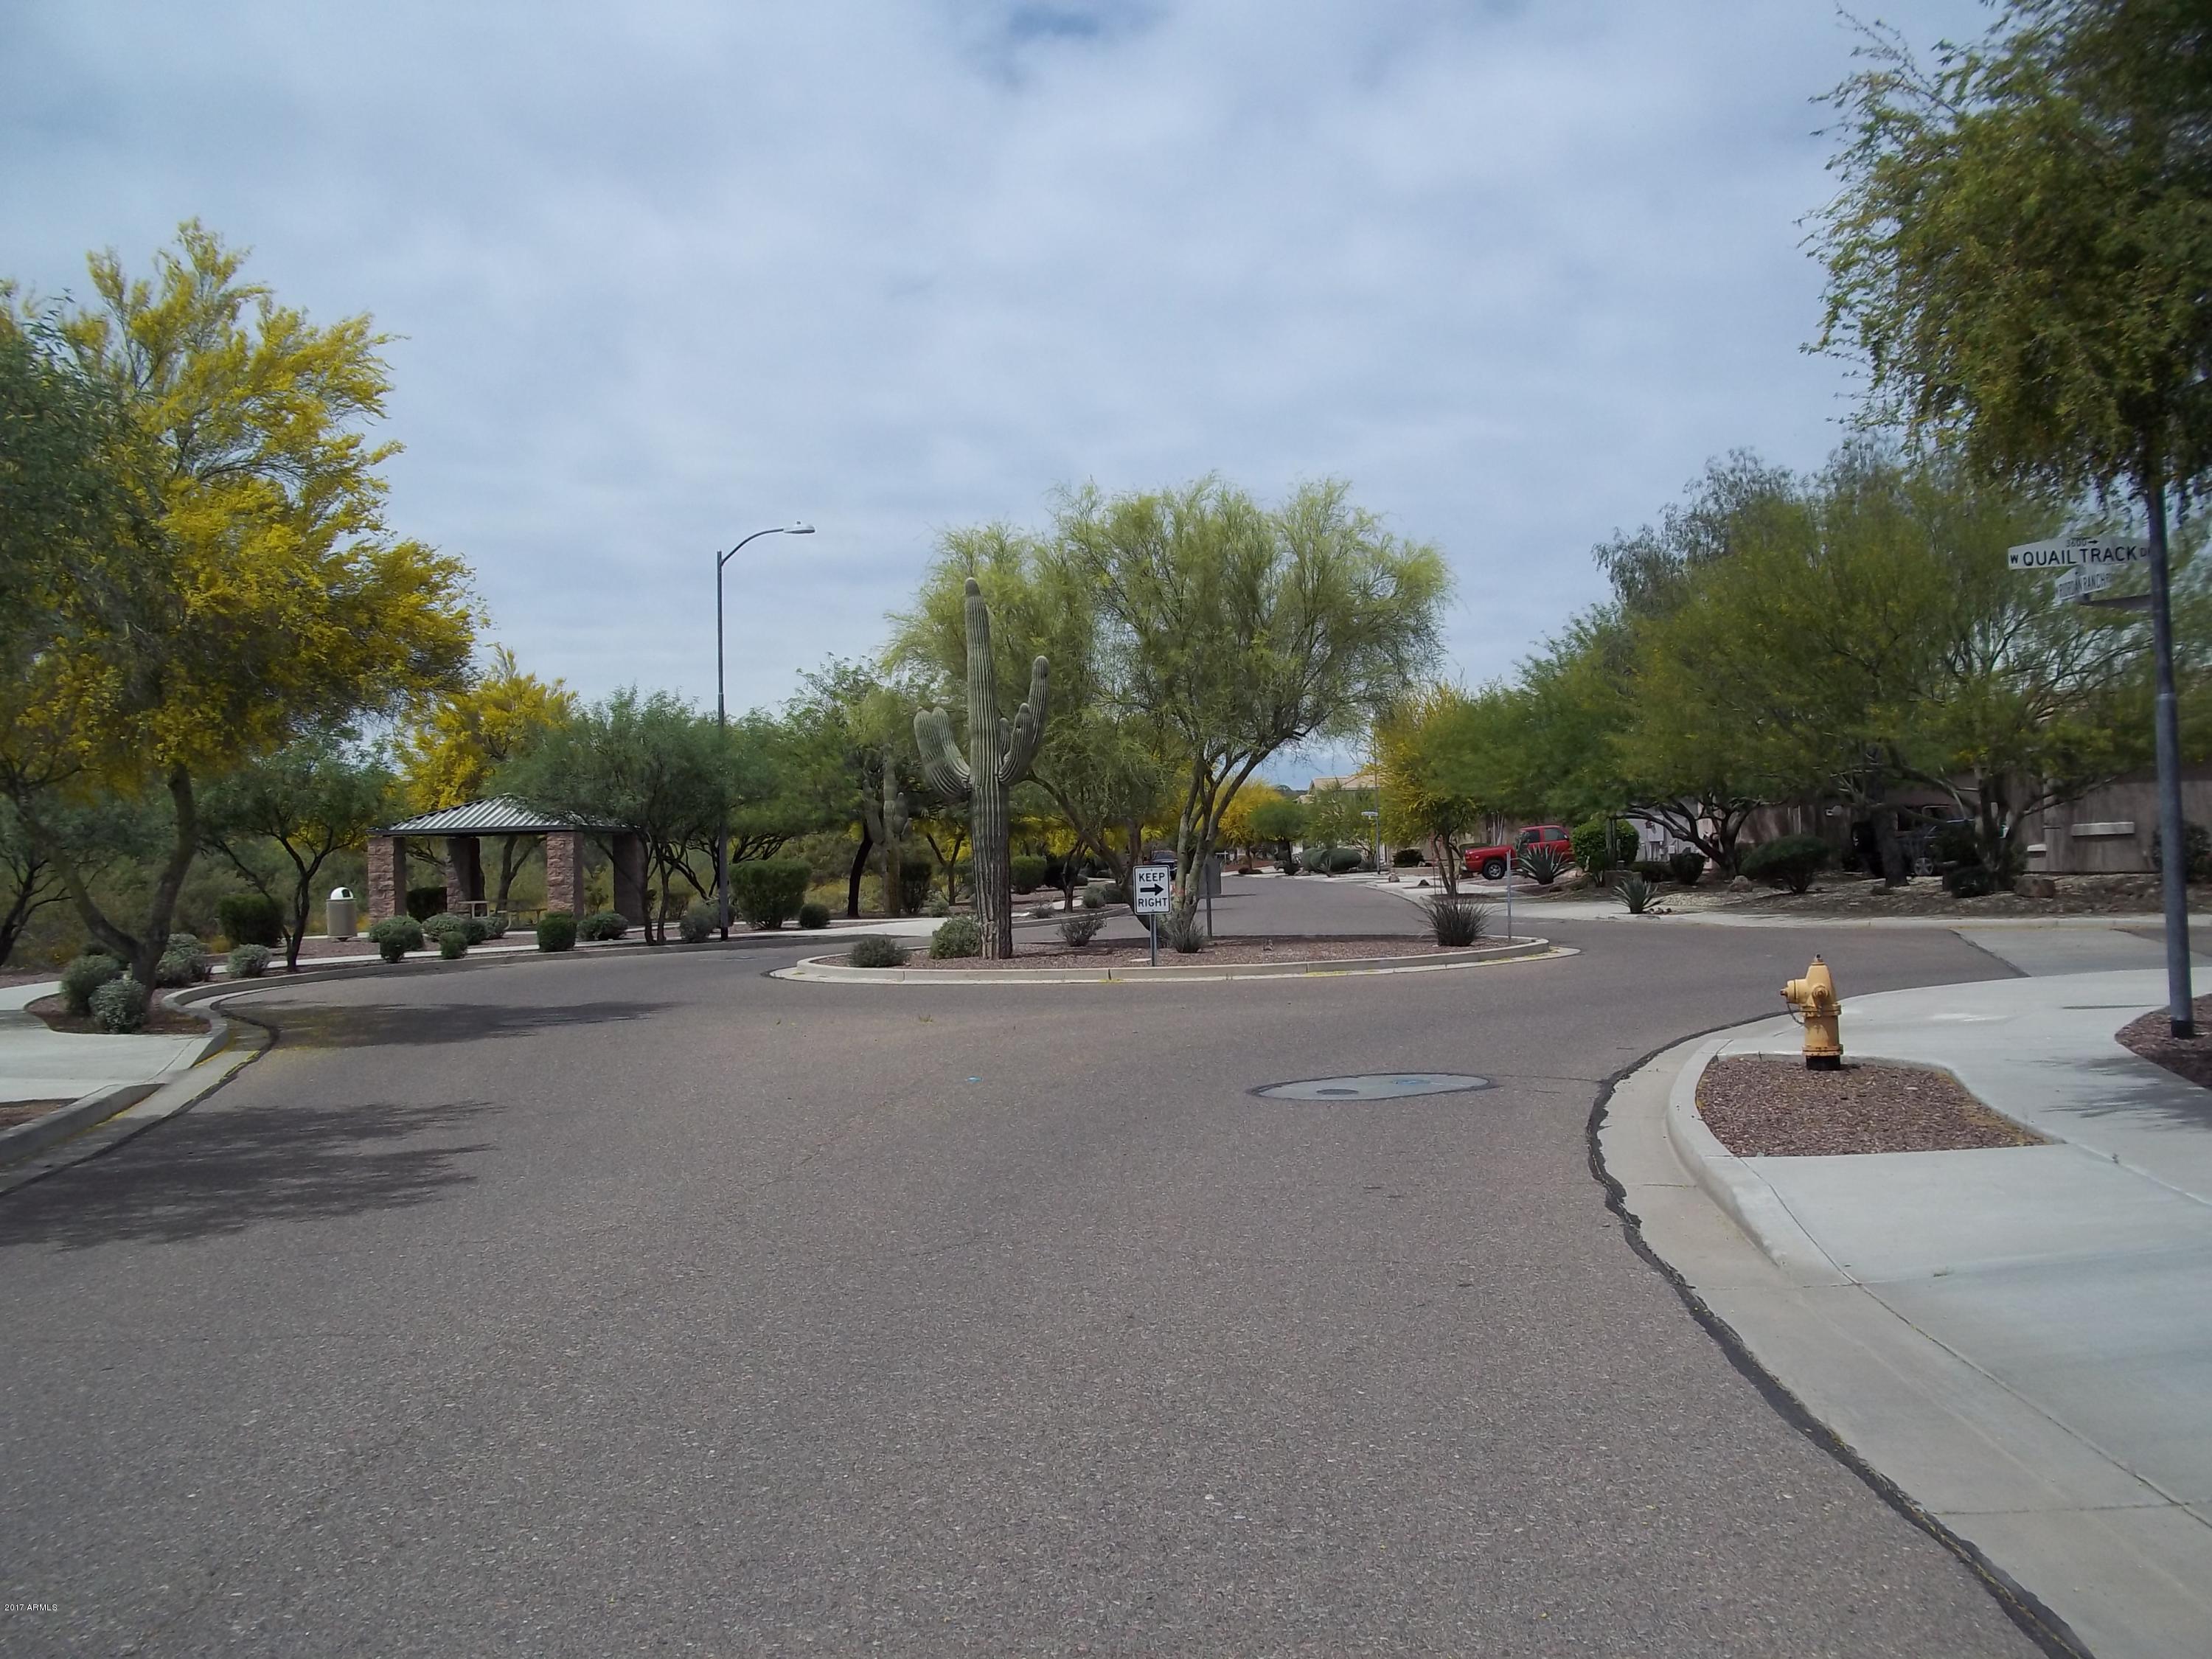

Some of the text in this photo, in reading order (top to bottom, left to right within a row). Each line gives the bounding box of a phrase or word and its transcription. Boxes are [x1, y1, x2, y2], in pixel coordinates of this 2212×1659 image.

[2010, 554, 2018, 564] W
[2023, 549, 2076, 566] QUAIL
[2081, 546, 2137, 563] TRACK
[1138, 872, 1165, 882] KEEP
[1138, 897, 1168, 907] RIGHT
